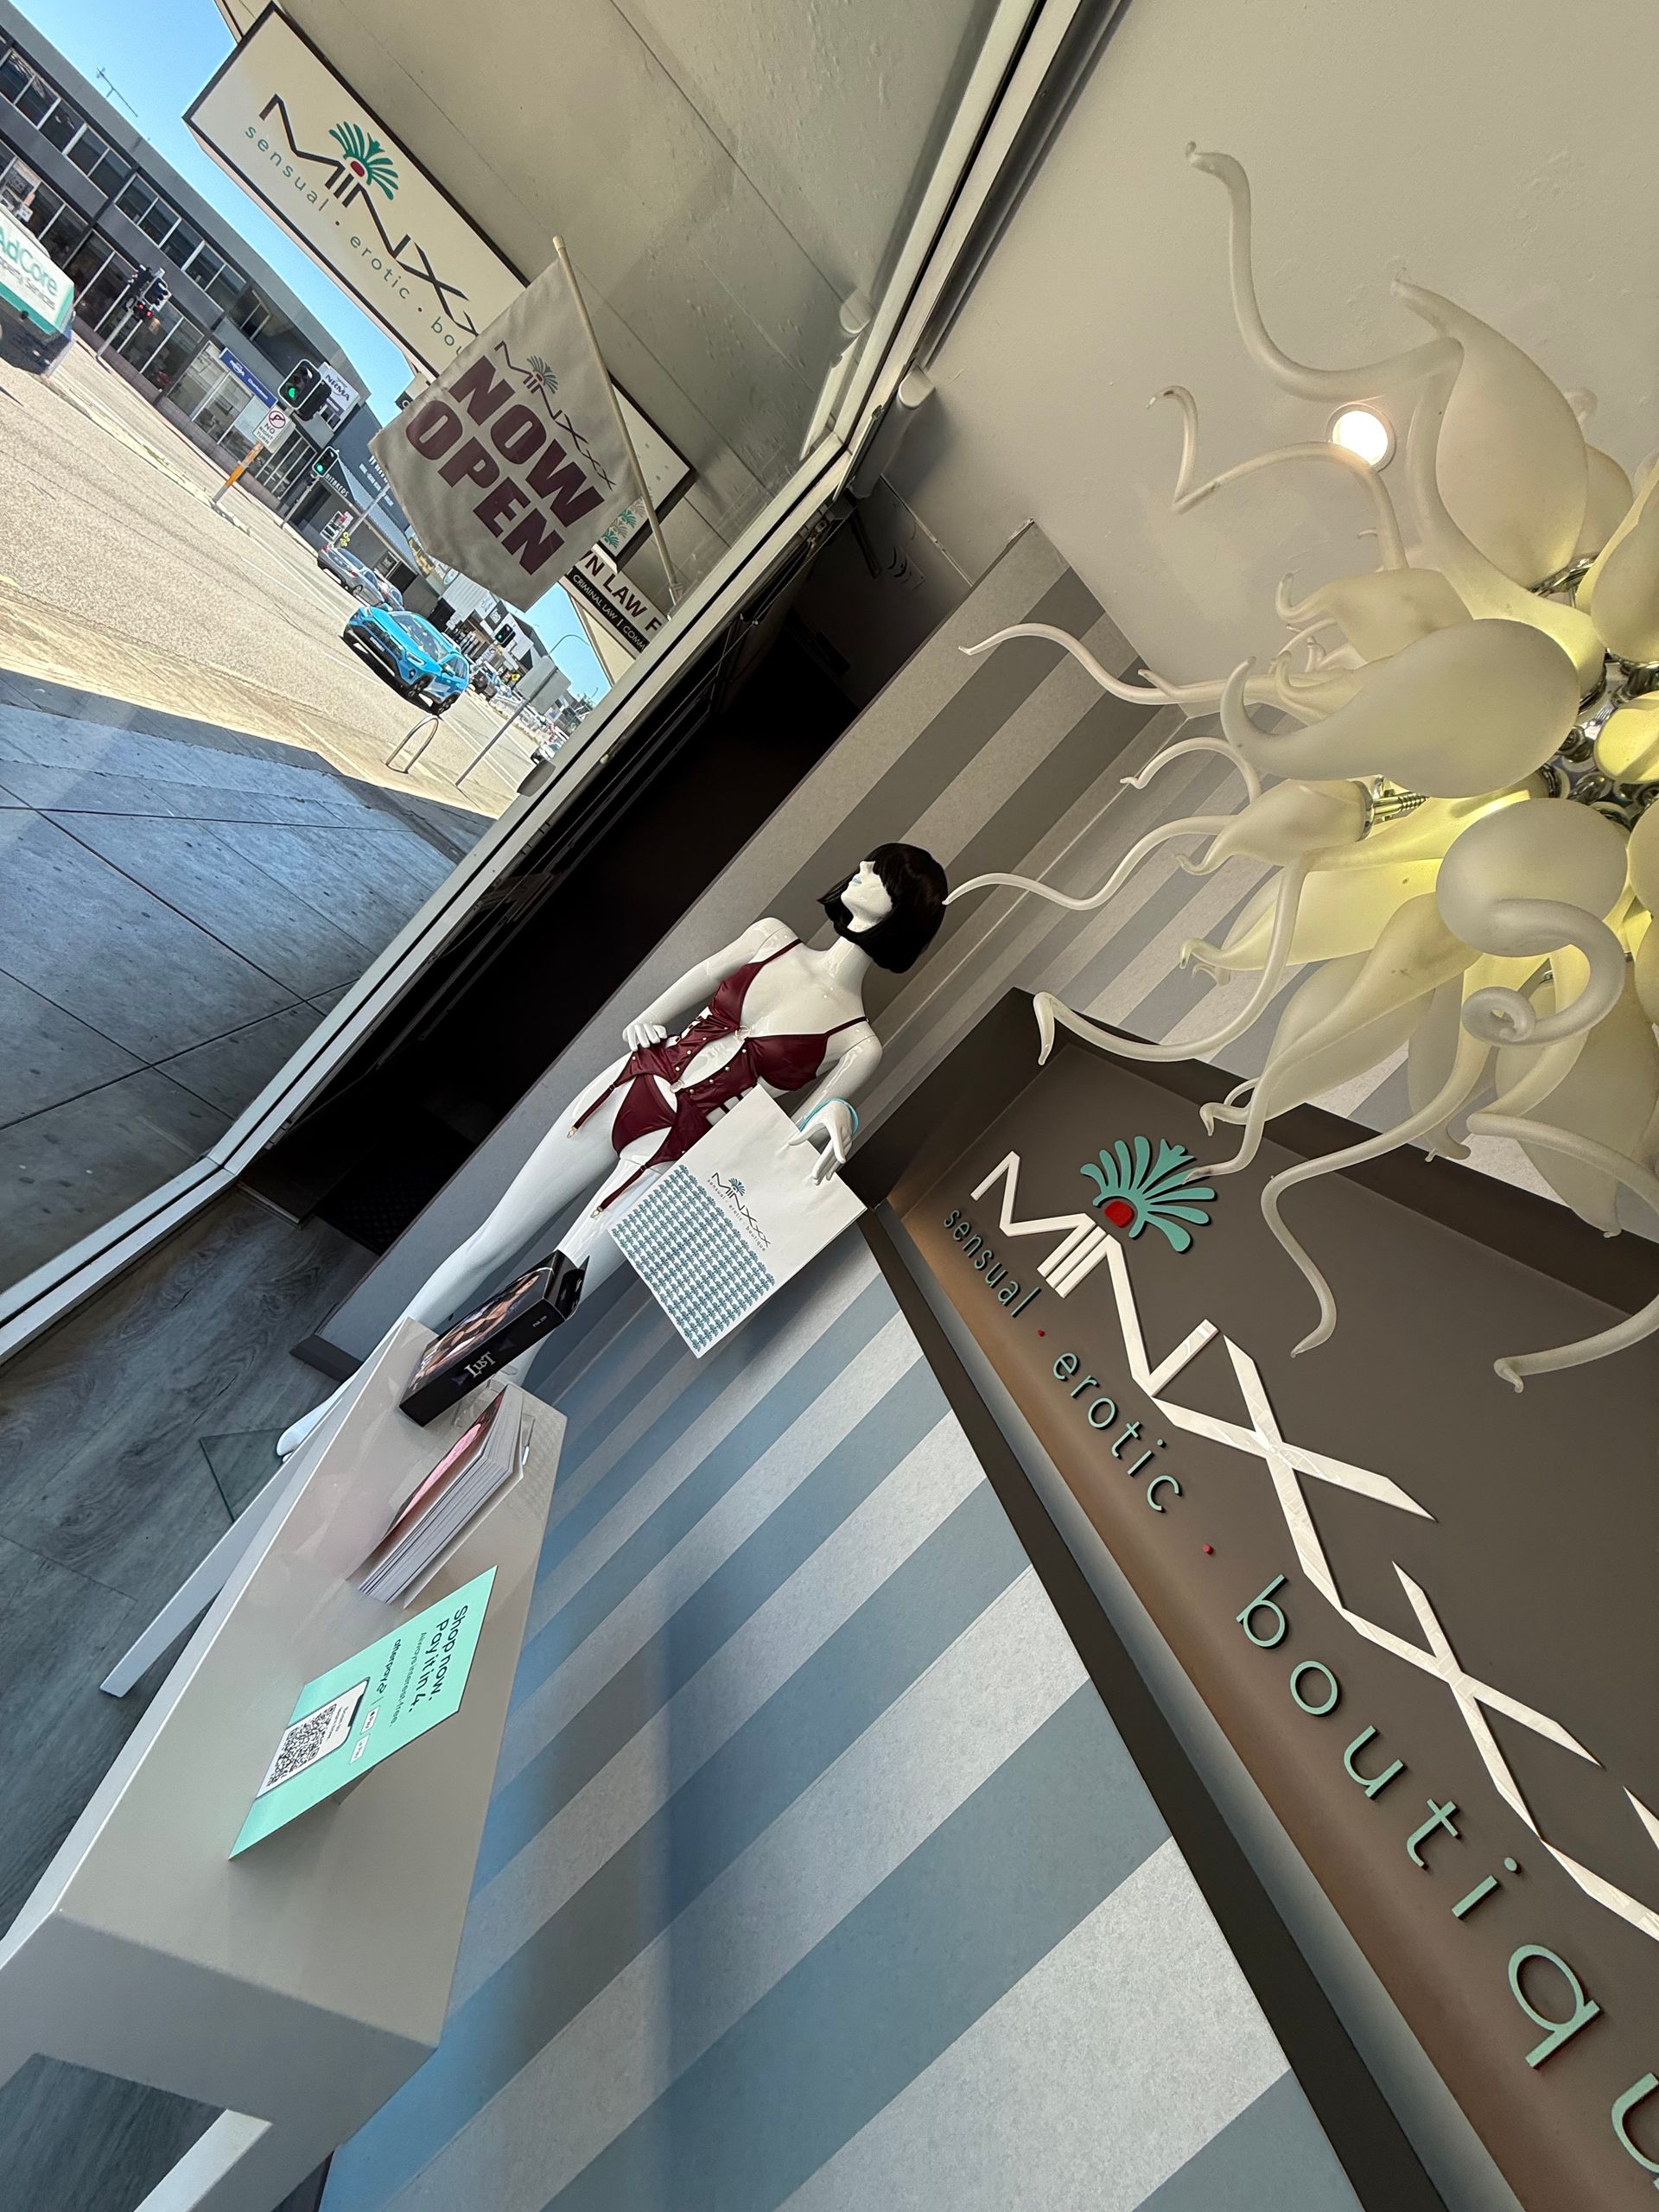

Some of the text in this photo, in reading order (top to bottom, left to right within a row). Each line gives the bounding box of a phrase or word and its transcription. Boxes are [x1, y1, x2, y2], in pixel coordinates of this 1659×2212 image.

[245, 125, 329, 213] sensual
[350, 235, 410, 301] erotic
[258, 426, 274, 441] RIGHT
[264, 423, 276, 435] NO
[325, 374, 350, 402] NRMA
[405, 400, 565, 575] OPEN
[448, 355, 605, 528] NOW
[572, 574, 646, 651] CRIMINAL LAW COMM
[603, 573, 647, 618] LAW
[707, 1178, 766, 1252] sensual erotic boutique
[389, 1632, 427, 1727] Always interest-free.
[409, 1618, 449, 1713] Pay it in 4.
[429, 1605, 468, 1700] Shop now.
[944, 1206, 1659, 2191] sensual erotic boutiqu
